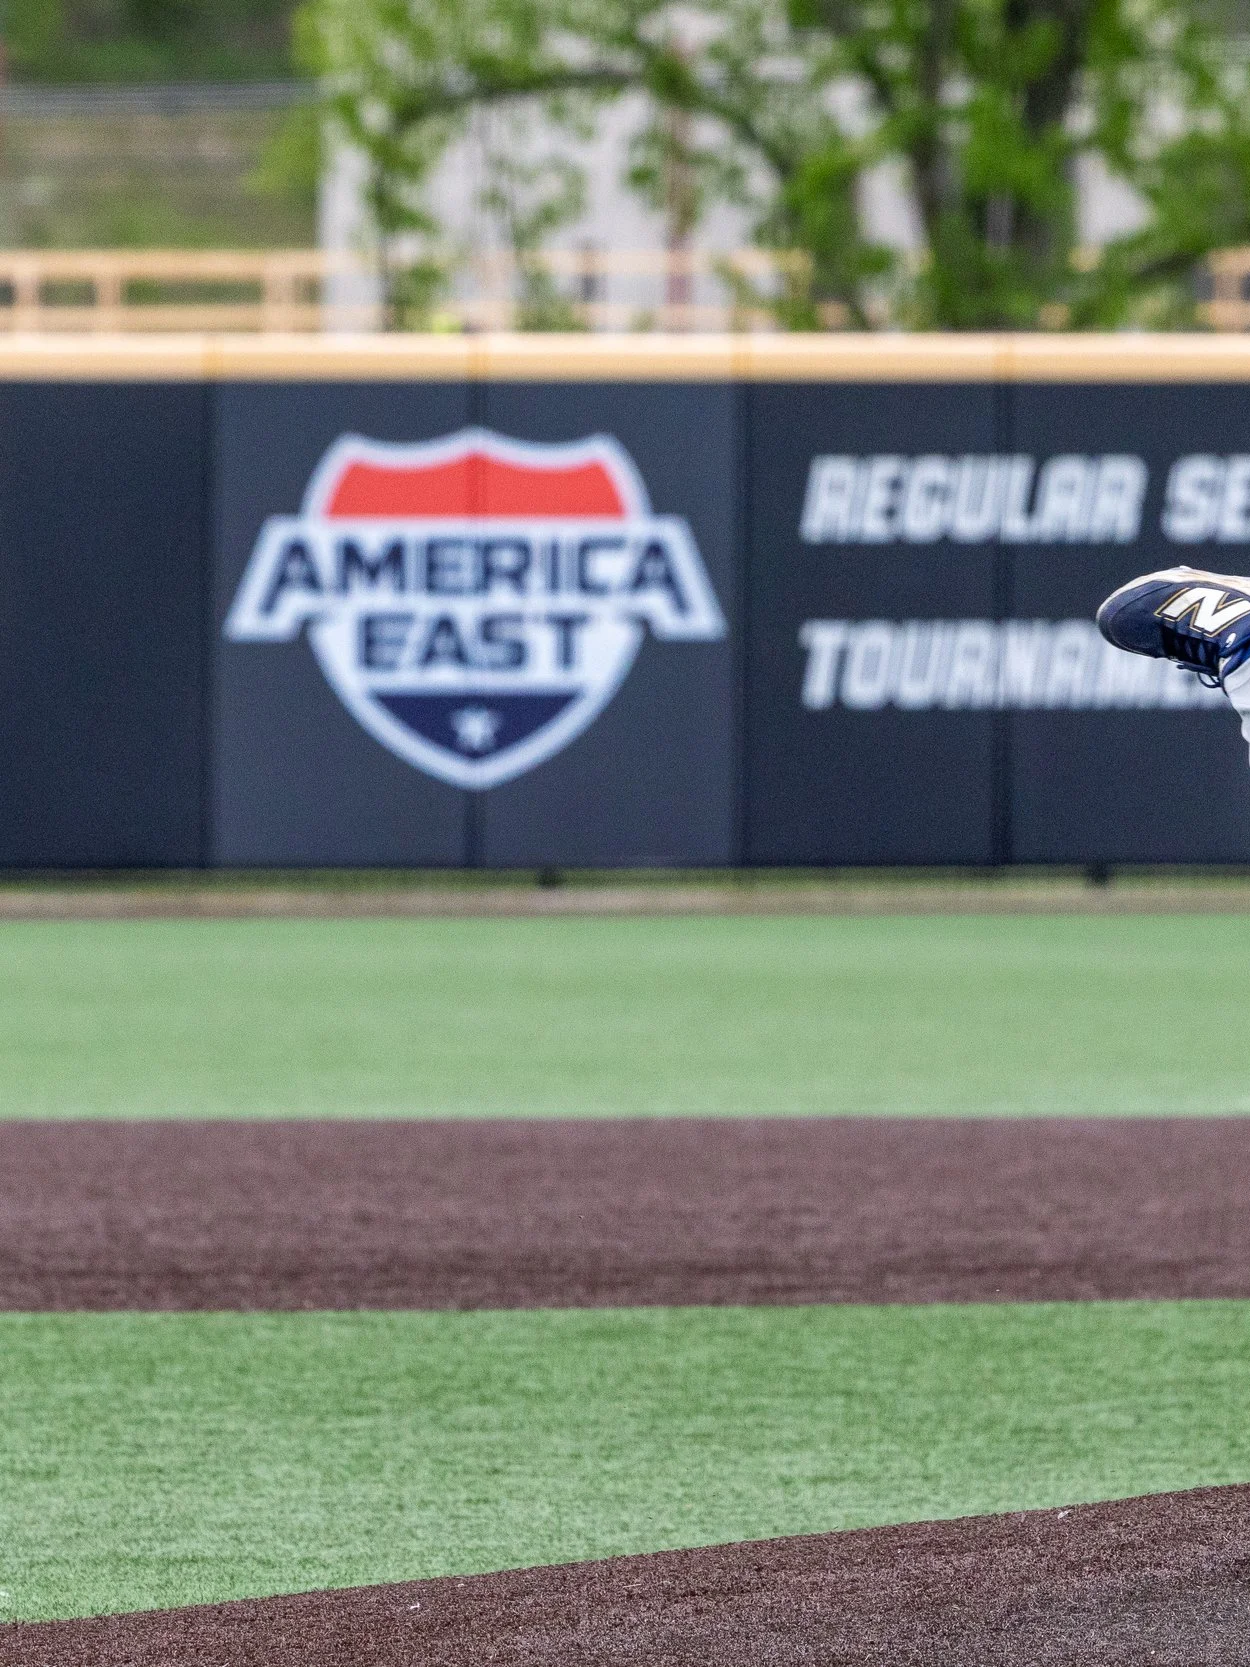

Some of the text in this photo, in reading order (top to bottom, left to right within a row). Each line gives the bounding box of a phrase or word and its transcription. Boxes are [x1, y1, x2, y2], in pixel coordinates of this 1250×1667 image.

[801, 454, 1149, 544] REGULAR
[256, 535, 694, 617] AMERICA
[358, 611, 594, 672] EAST
